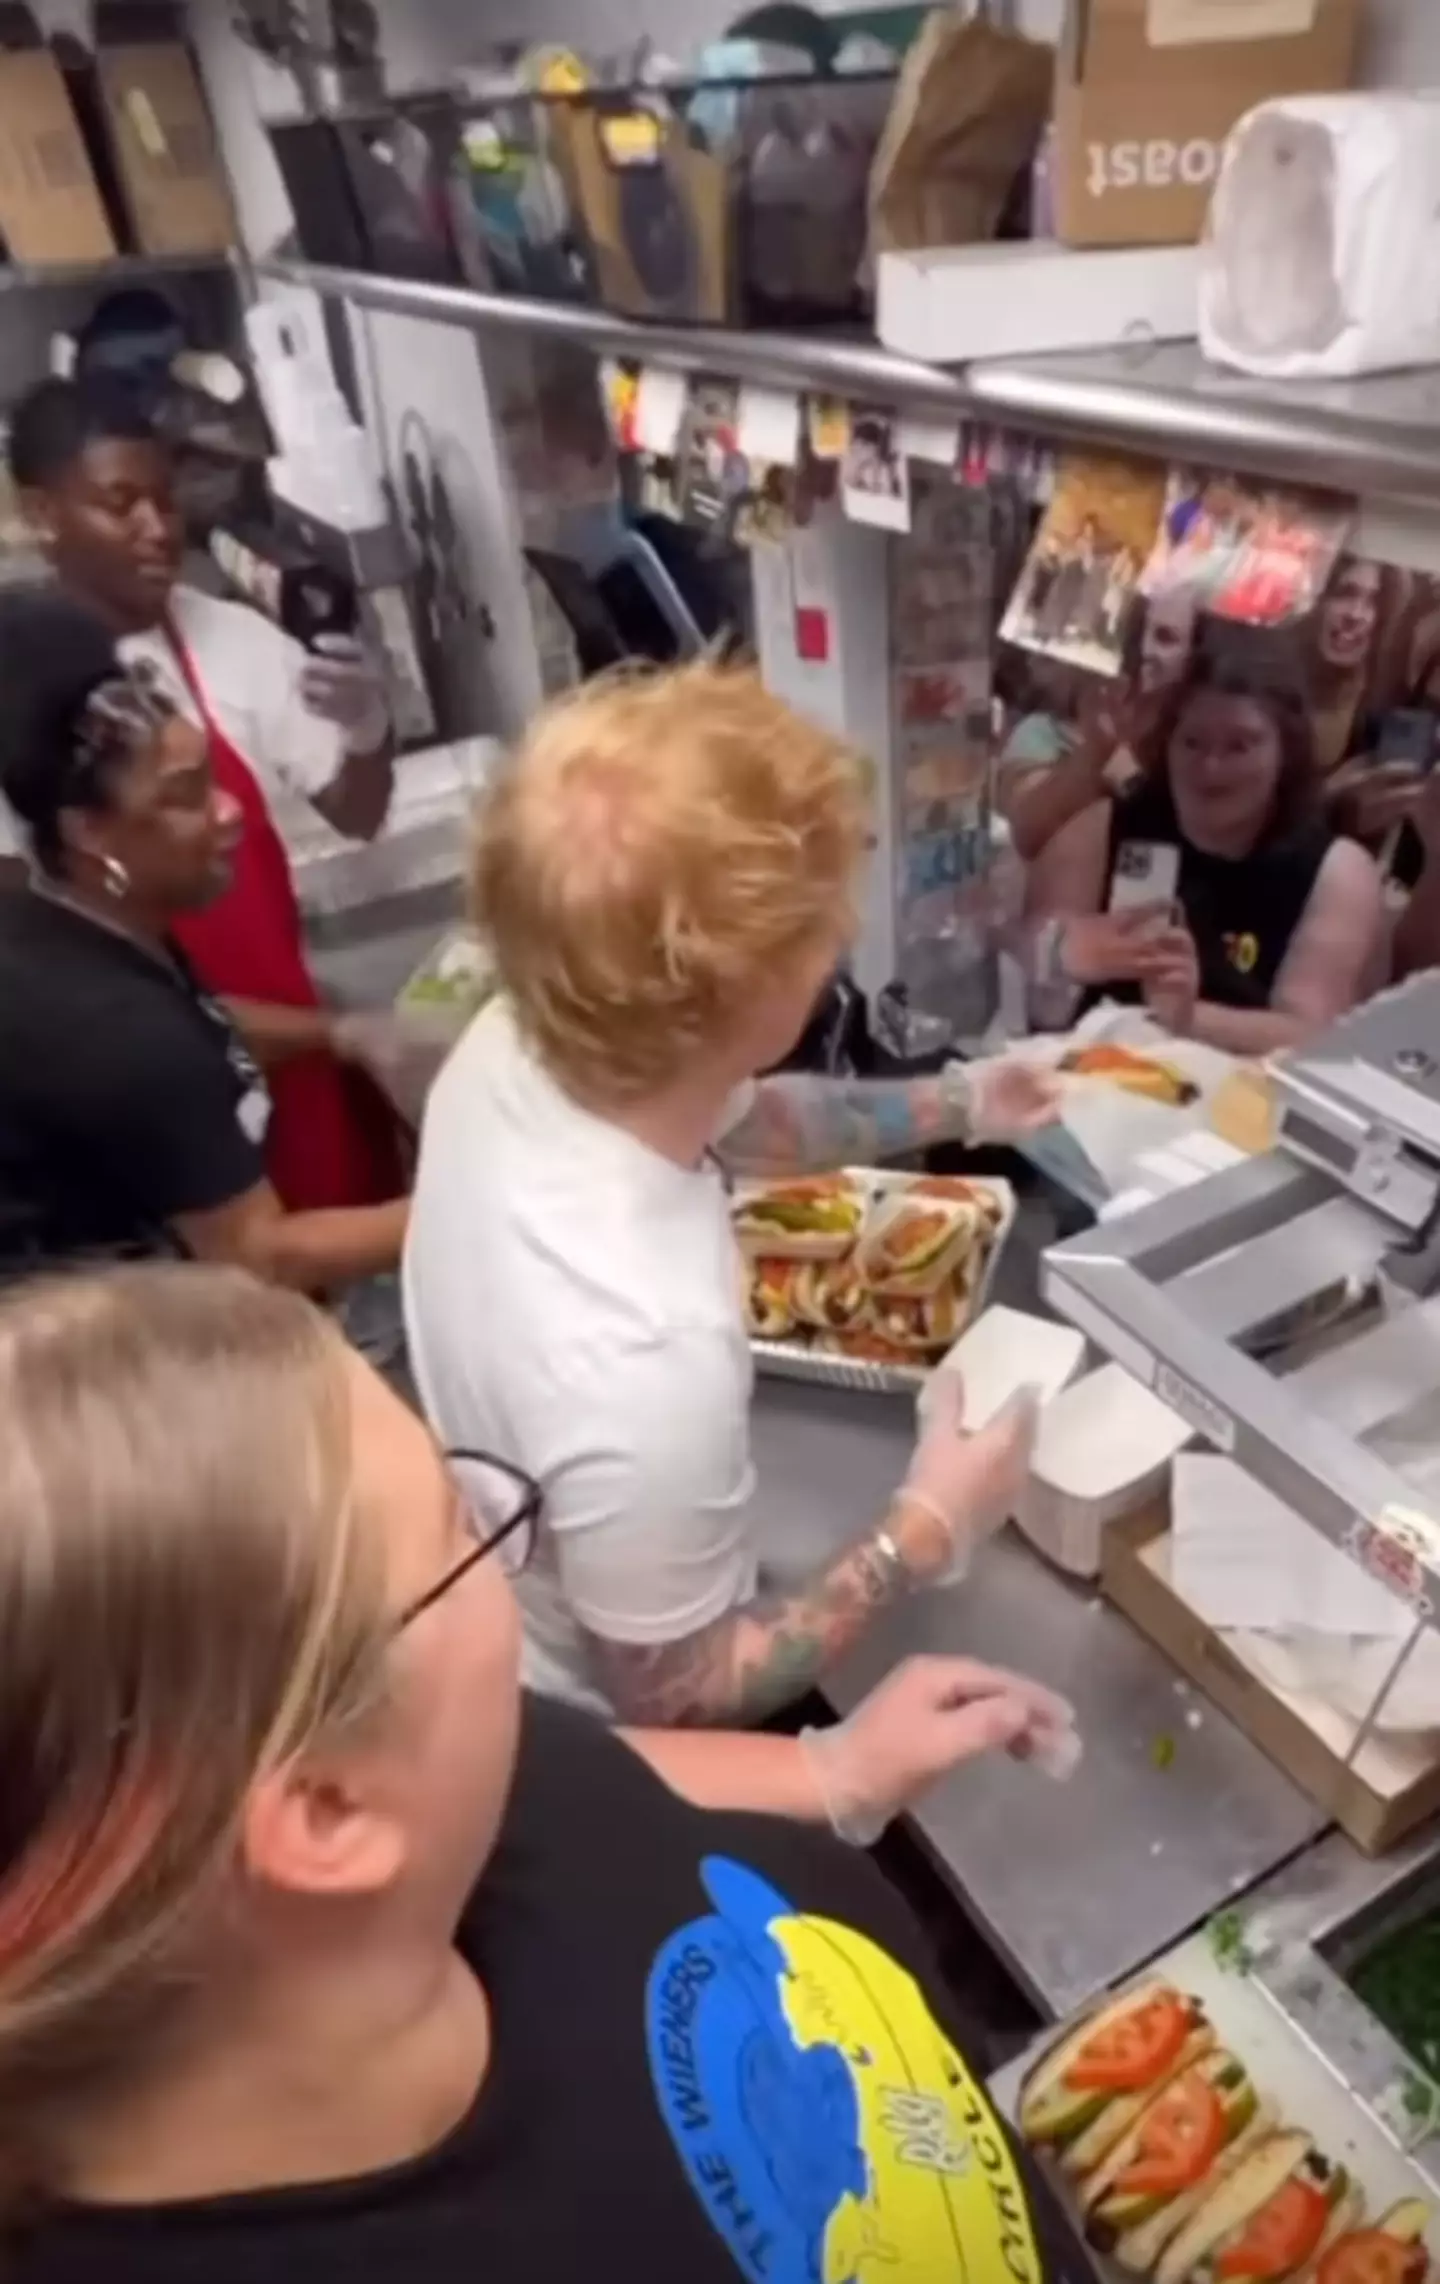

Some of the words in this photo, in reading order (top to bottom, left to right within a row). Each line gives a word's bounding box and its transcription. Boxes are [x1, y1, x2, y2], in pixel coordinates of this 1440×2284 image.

[1087, 138, 1216, 197] oast
[660, 1942, 716, 2131] WIENERS
[696, 2150, 770, 2273] THE
